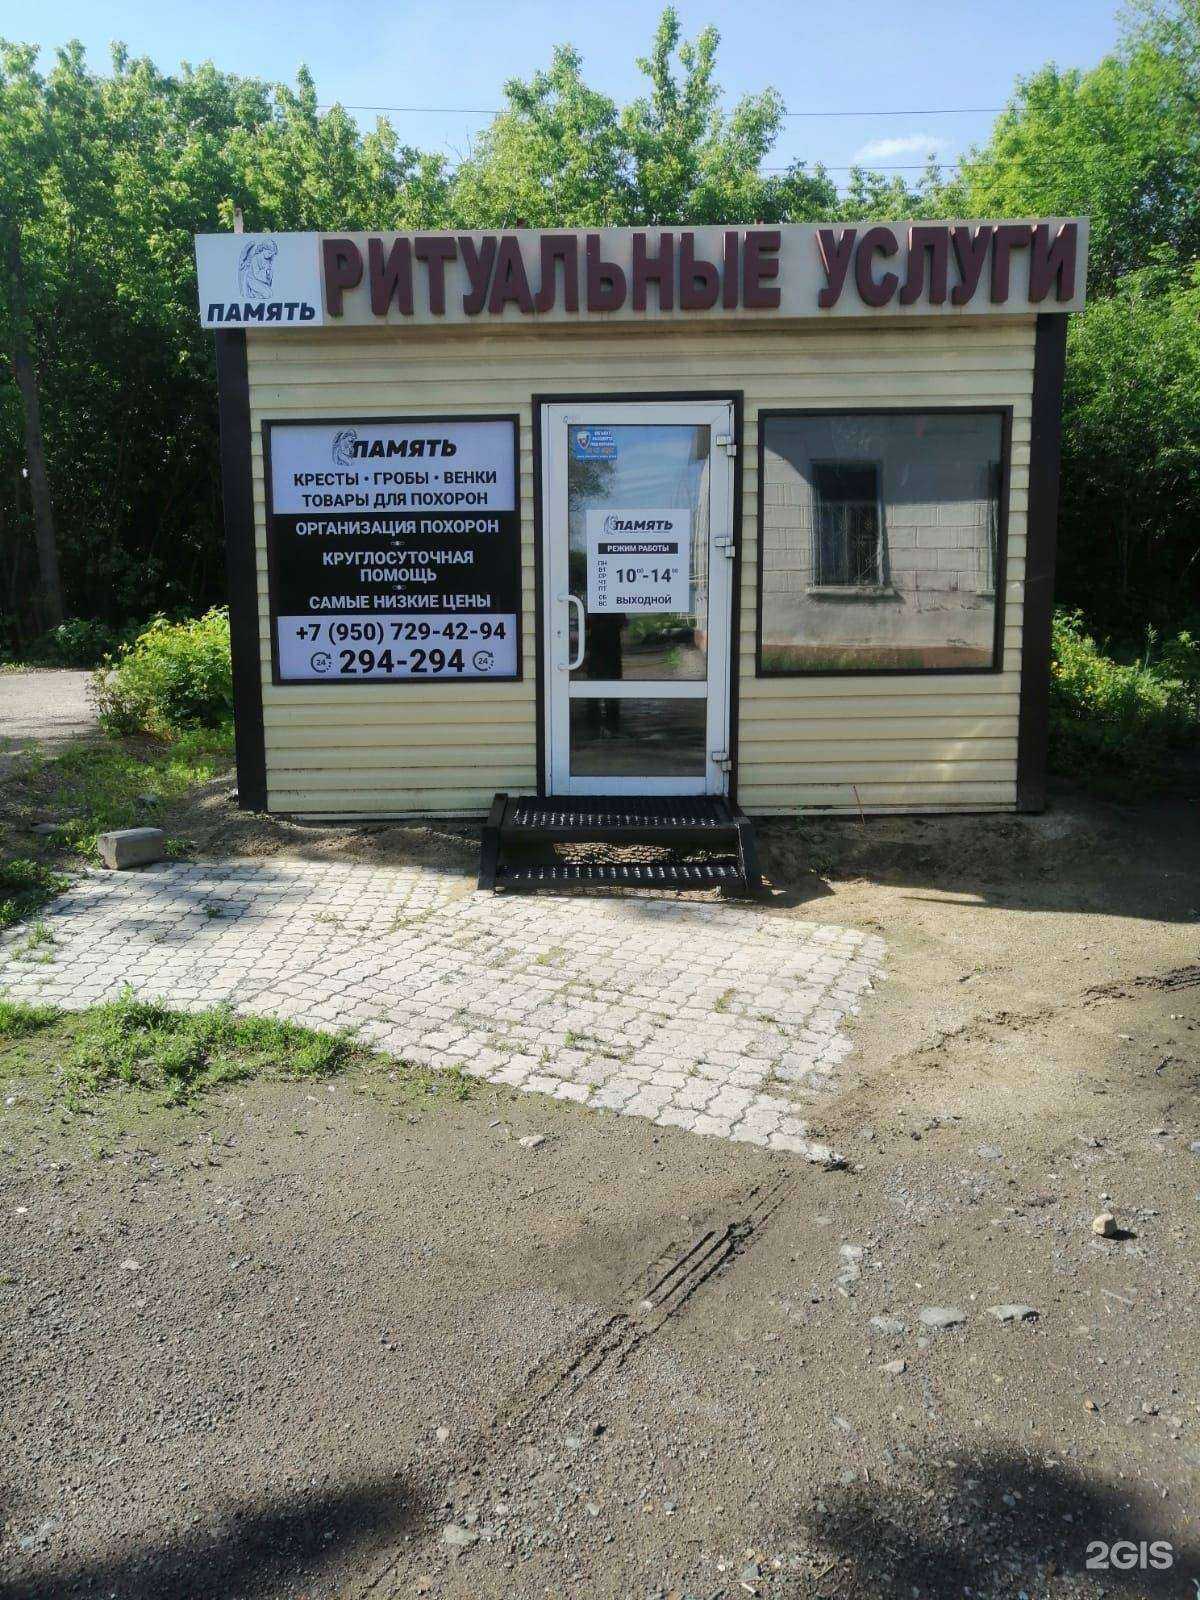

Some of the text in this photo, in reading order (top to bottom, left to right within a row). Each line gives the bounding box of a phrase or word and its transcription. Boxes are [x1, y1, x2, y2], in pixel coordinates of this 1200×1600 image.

[322, 223, 1078, 317] РИТУАЛЬНЫЕ УСЛУГИ
[207, 302, 316, 322] ПАМЯТЬ
[353, 439, 457, 458] ПАМЯТЬ
[294, 471, 497, 486] КРЕСТЫ ГРОБЫ ВЕНКИ
[302, 492, 488, 509] ТОВАРЫ ДЛЯ ПОХОРОН
[296, 519, 499, 536] ОРГАНИЗАЦИЯ ПОХОРОН
[614, 520, 674, 531] ПАМЯТЬ
[323, 551, 474, 566] КРУГЛОСУТОЧНАЯ
[360, 569, 437, 583] ПОМОЩЬ
[309, 594, 491, 611] САМЫЕ НИЗКИЕ ЦЕНЫ
[616, 594, 672, 606] ВЫХОДНОЙ
[296, 622, 506, 645] +7 (950) 729-42-94
[339, 649, 465, 674] 294-294
[478, 656, 489, 666] 24
